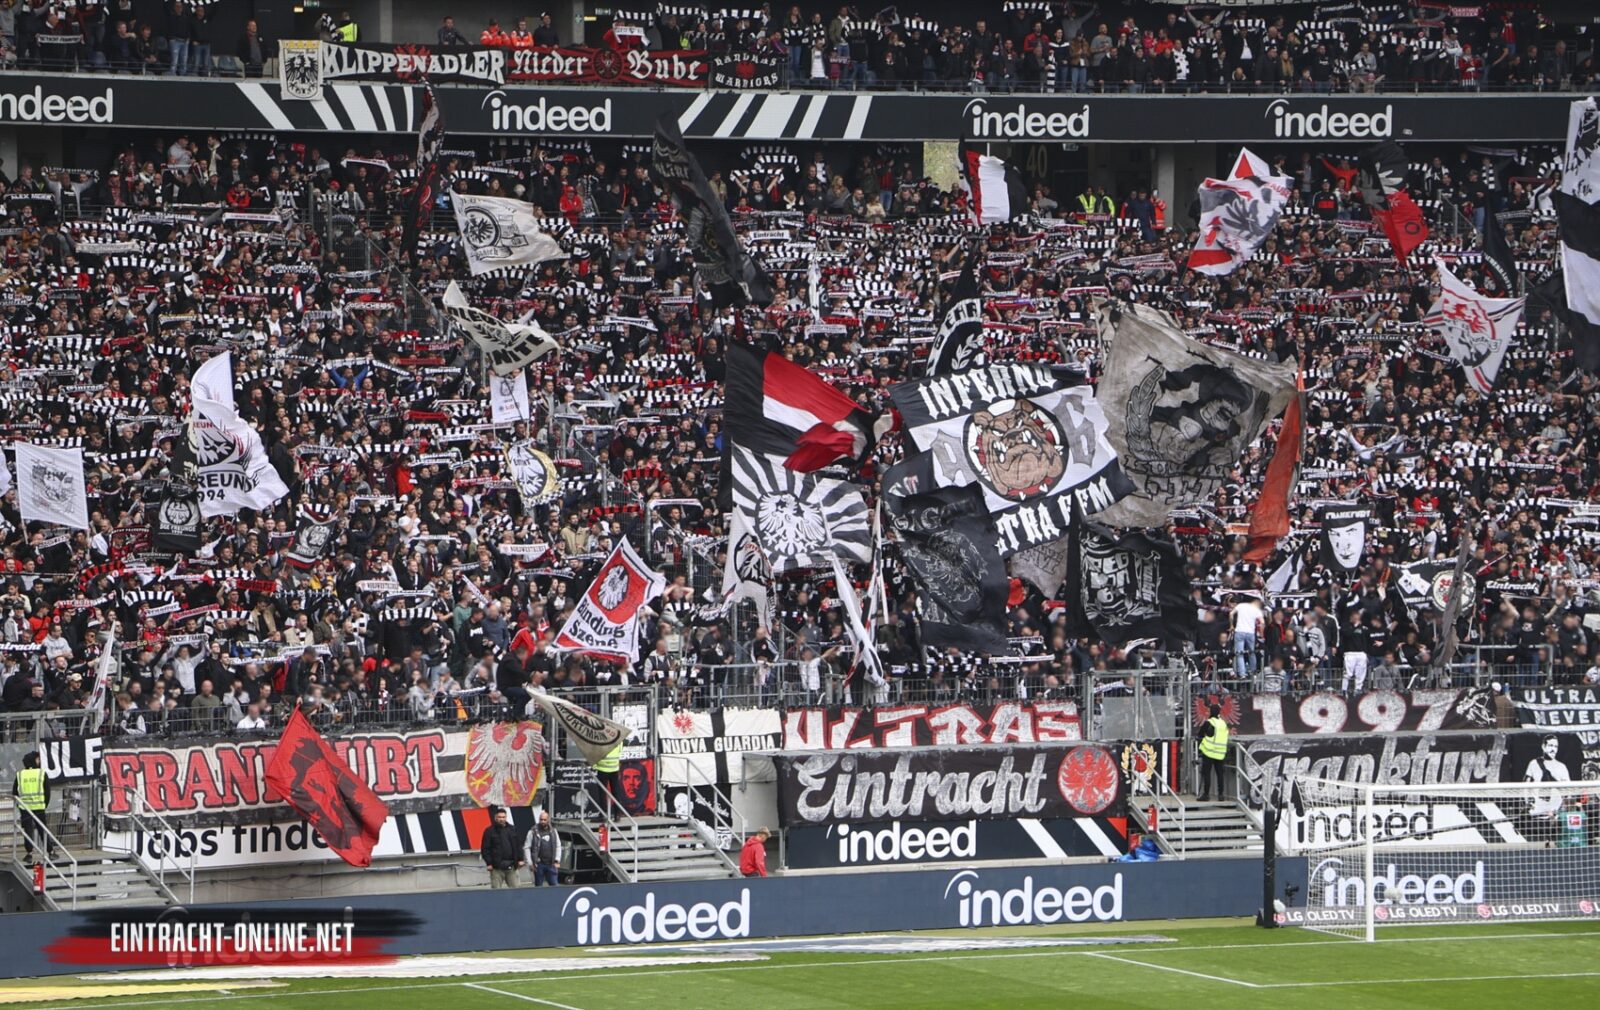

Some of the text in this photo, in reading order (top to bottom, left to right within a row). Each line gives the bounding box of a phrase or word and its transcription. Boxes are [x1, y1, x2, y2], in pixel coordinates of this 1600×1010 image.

[322, 42, 504, 84] KLIPPENADLER
[511, 49, 701, 81] Nieder Bube
[0, 85, 113, 124] ndeed
[492, 97, 612, 132] indeed
[972, 103, 1090, 138] indeed
[1274, 104, 1392, 138] indeed
[569, 621, 619, 649] Szene
[576, 598, 626, 638] Binding
[784, 701, 1082, 751] ULTRAS
[1252, 689, 1461, 735] 1997
[661, 735, 776, 754] NUOVA GUARDIA
[793, 753, 1047, 823] Eintracht
[1245, 733, 1507, 805] Frankfurt
[837, 819, 977, 863] indeed
[1296, 808, 1434, 845] indeed
[957, 872, 1123, 927] indeed
[1322, 860, 1484, 907] indeed
[576, 888, 750, 945] indeed
[1287, 910, 1354, 922] LG OLED TV
[1389, 906, 1457, 918] LG OLED TV
[1492, 903, 1559, 915] LG OLED TV
